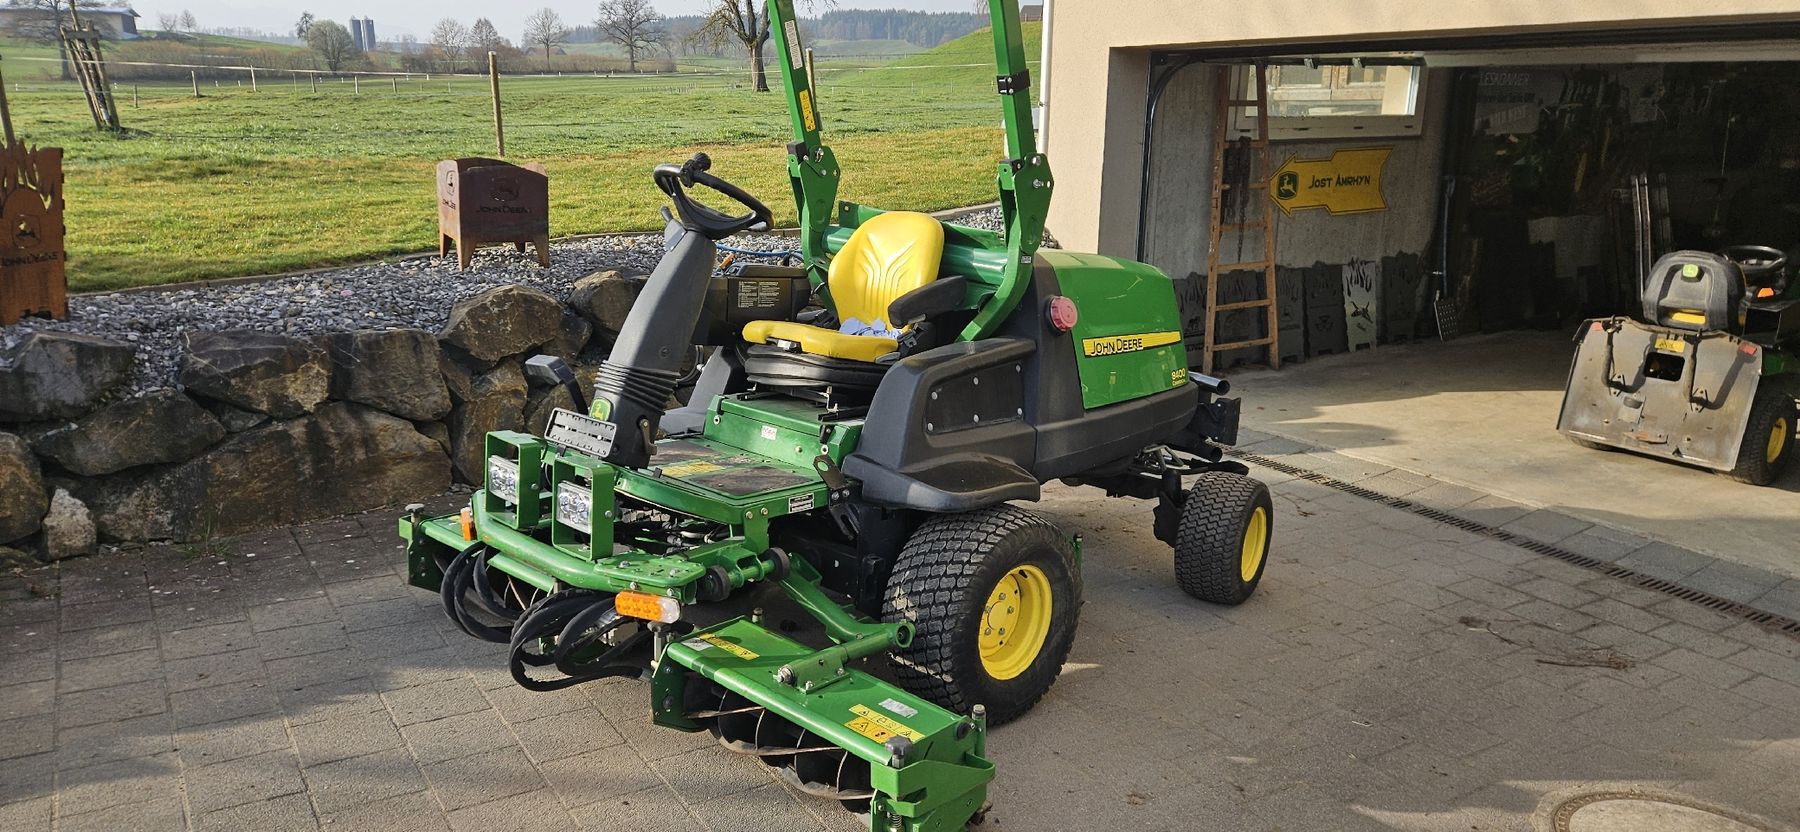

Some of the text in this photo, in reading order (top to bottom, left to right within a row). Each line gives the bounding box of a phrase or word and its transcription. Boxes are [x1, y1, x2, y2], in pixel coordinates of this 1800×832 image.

[1308, 175, 1333, 188] JOST
[1091, 338, 1144, 356] JOHN DEERE
